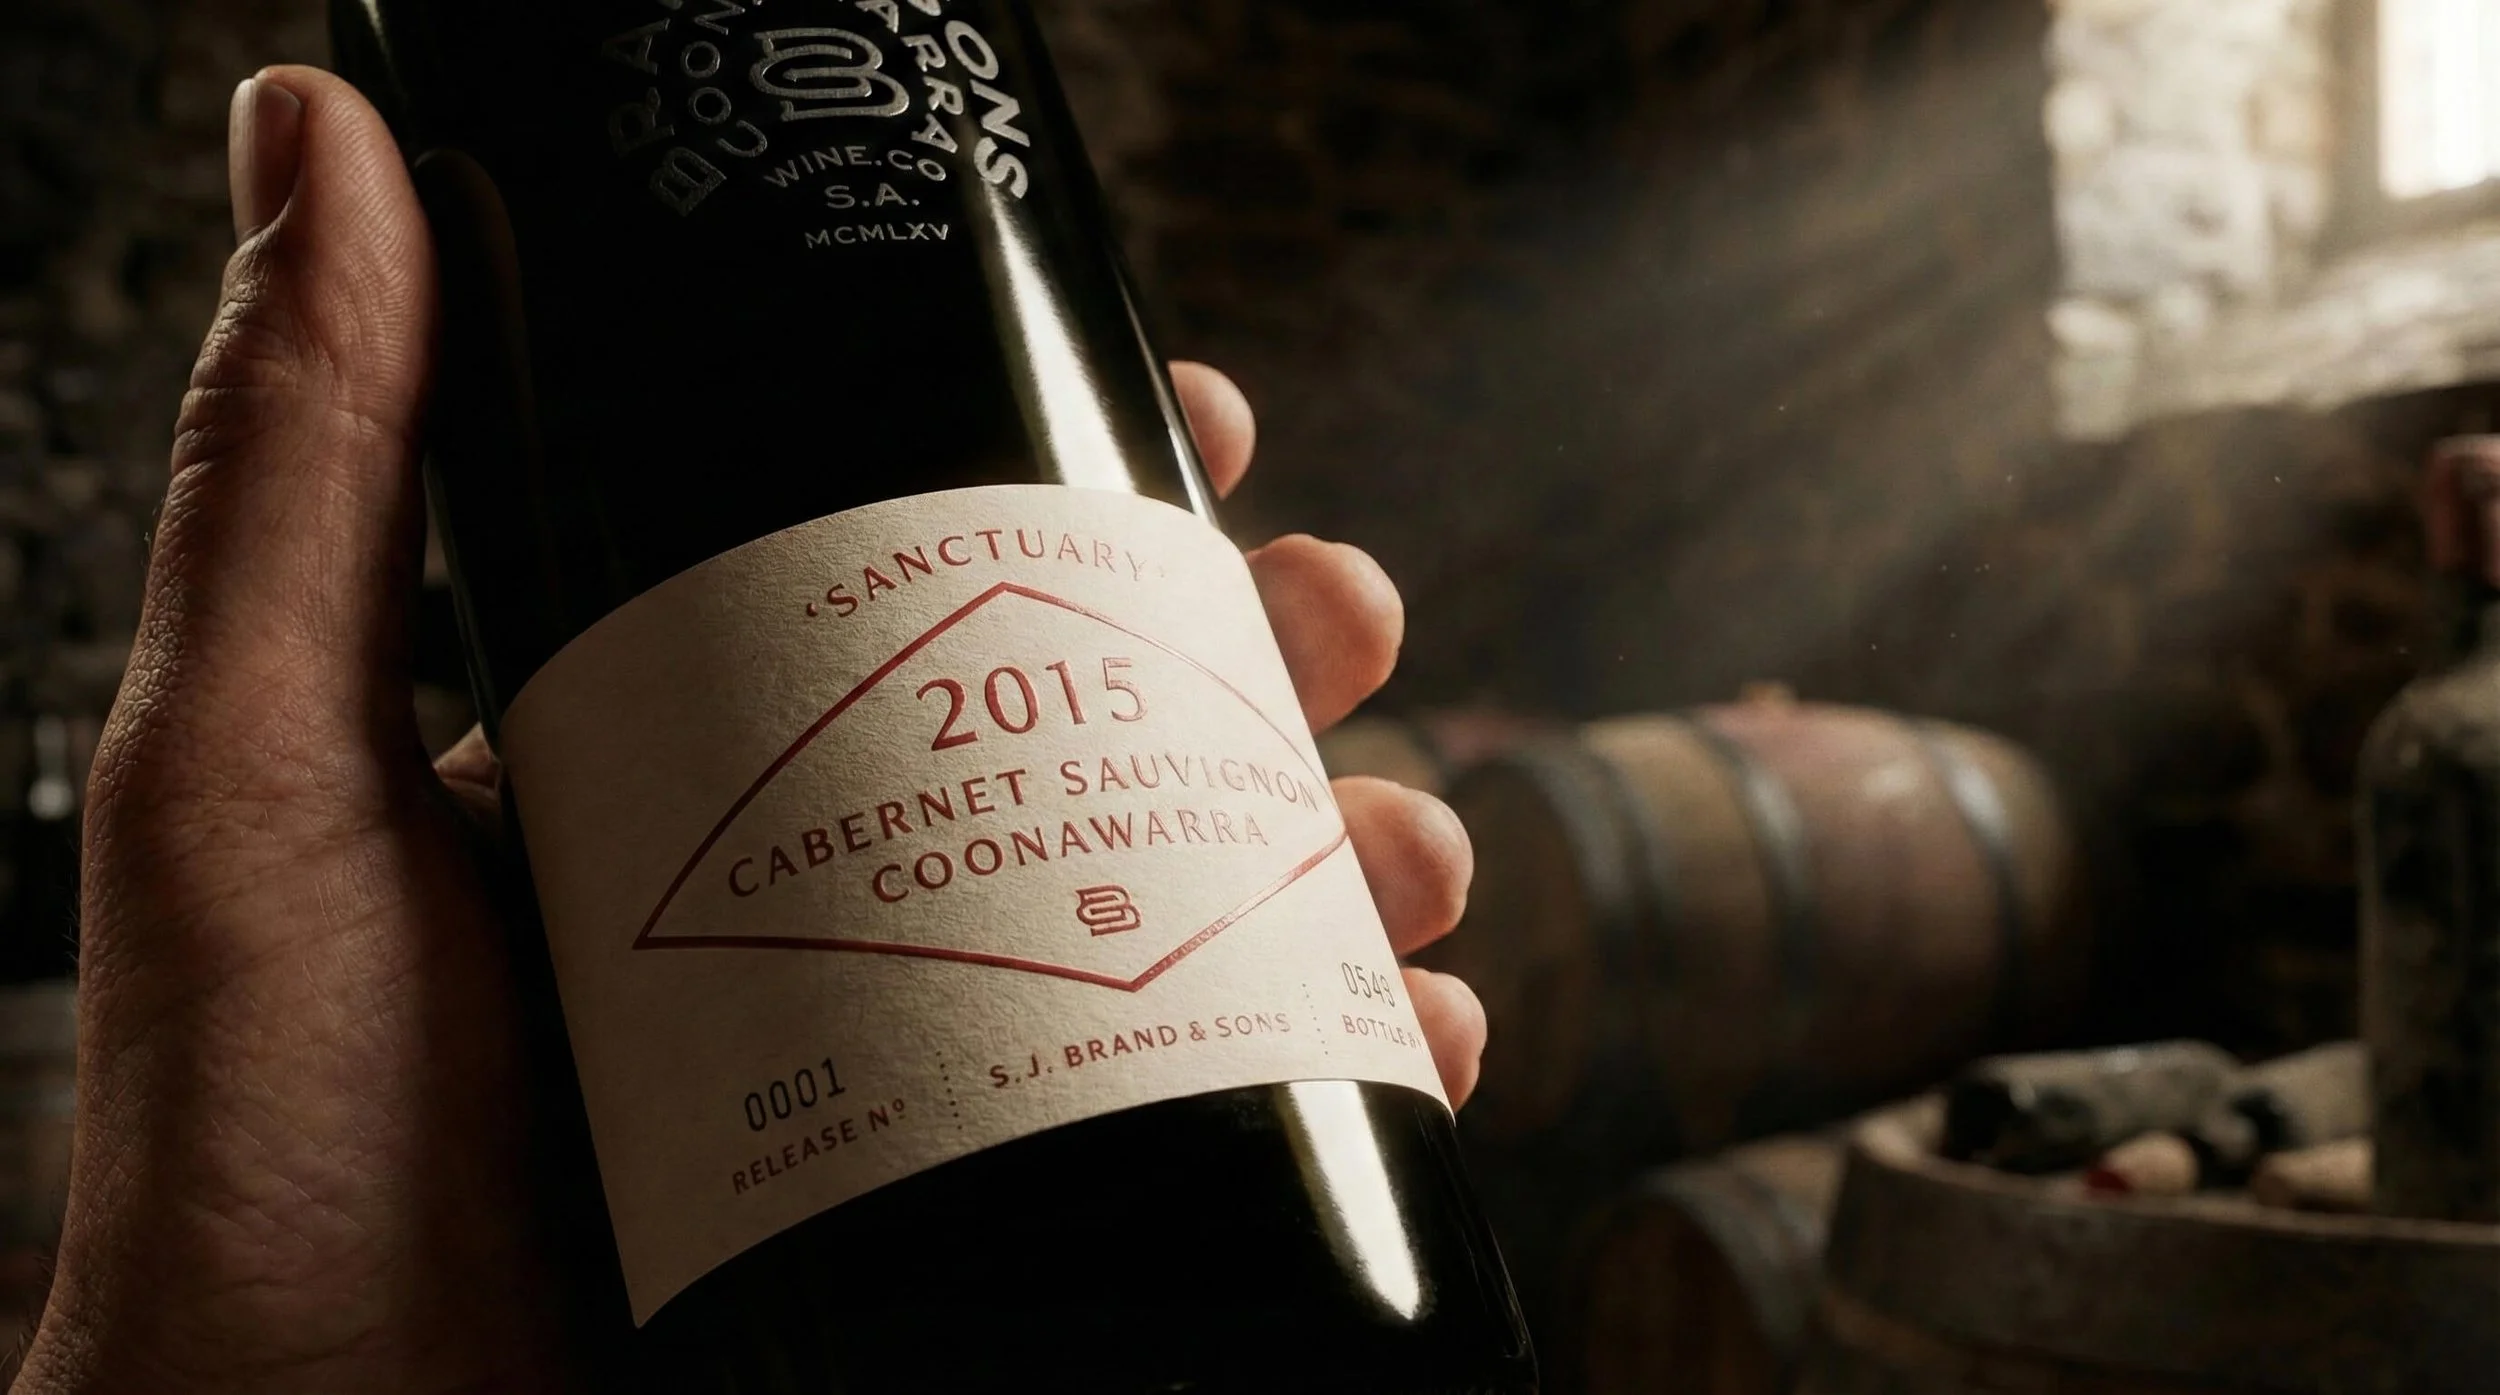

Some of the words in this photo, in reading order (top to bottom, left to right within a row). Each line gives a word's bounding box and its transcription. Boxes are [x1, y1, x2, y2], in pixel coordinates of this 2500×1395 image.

[823, 183, 921, 209] S.A.
[803, 221, 949, 250] MCMLXV
[915, 655, 1148, 751] 2015
[727, 769, 1028, 898] CABERNET
[1059, 753, 1320, 813] SAUVIGNON
[871, 808, 1270, 904] COONAWARRA
[1064, 1024, 1178, 1069] BRAND
[1189, 1020, 1206, 1042] &
[1214, 1011, 1291, 1037] SONS
[1341, 1013, 1407, 1047] BOTTLE
[744, 1057, 846, 1132] 0001
[731, 1118, 858, 1195] RELEASE
